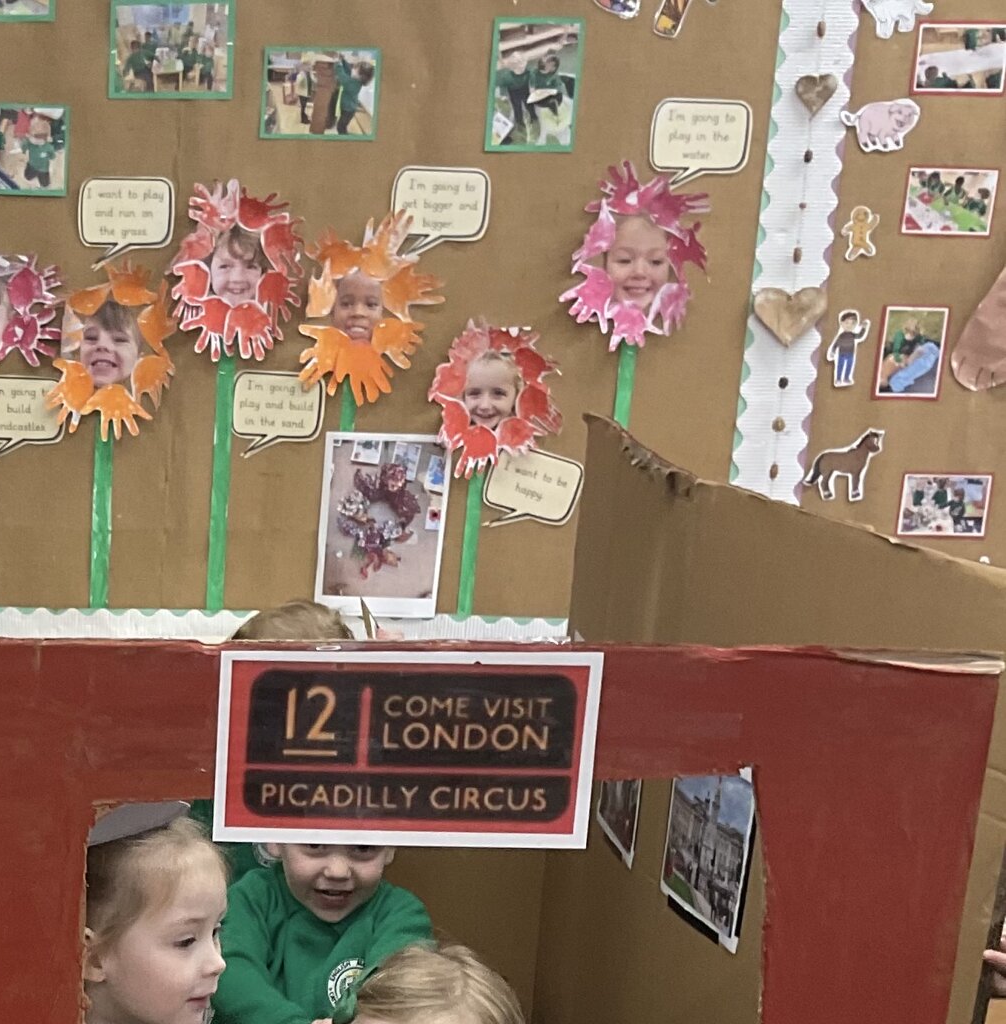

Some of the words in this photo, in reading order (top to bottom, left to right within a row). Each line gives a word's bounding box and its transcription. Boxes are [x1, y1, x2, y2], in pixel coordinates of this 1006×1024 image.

[725, 112, 737, 123] to
[668, 130, 691, 144] play
[713, 130, 730, 142] the
[432, 183, 460, 195] going
[465, 181, 476, 192] to
[127, 189, 139, 200] to
[143, 188, 164, 203] play
[94, 206, 114, 217] and
[423, 199, 453, 213] bigger
[458, 200, 479, 211] and
[6, 403, 32, 414] build
[289, 400, 314, 412] build
[285, 685, 337, 741] 12
[383, 694, 470, 719] COME
[484, 697, 553, 720] VISIT
[383, 722, 549, 752] LONDON
[260, 782, 421, 810] PICADILLY
[429, 786, 548, 813] CIRCUS
